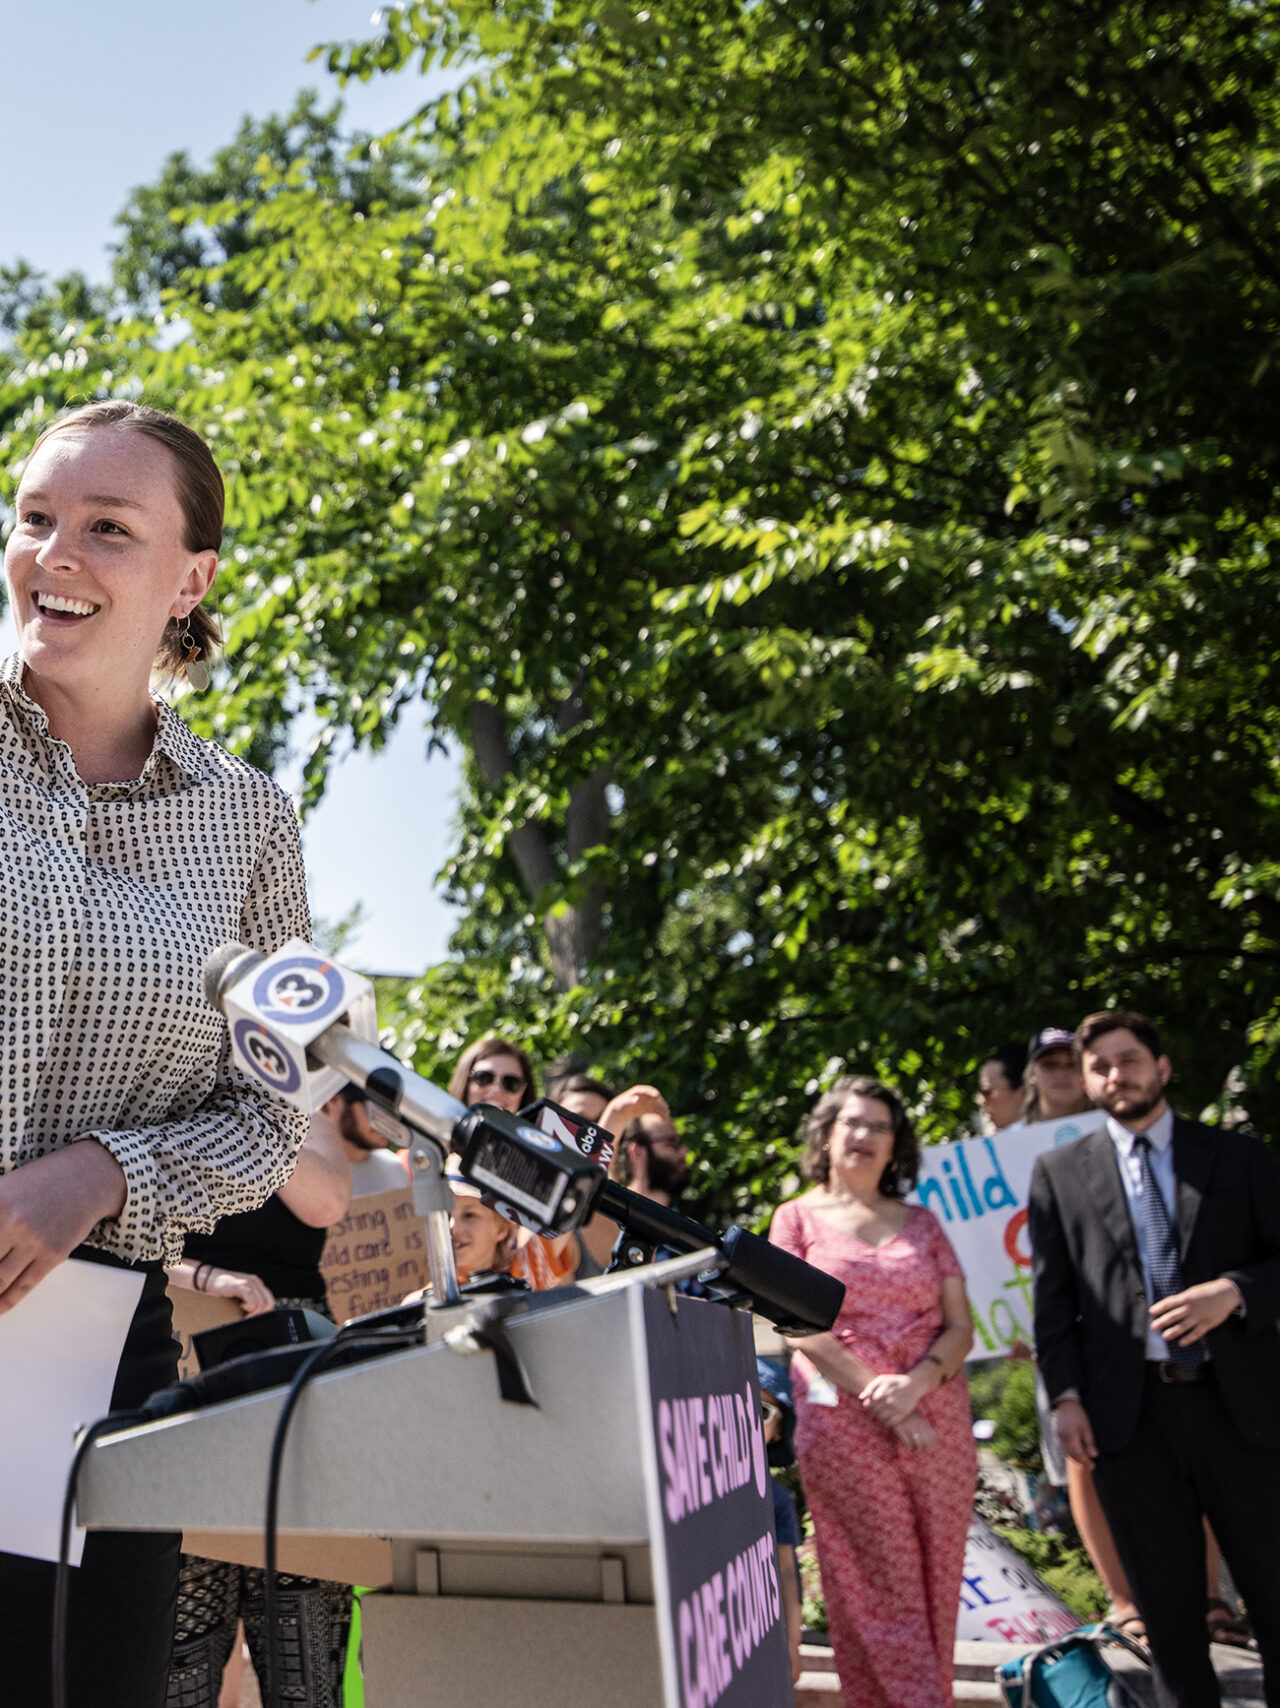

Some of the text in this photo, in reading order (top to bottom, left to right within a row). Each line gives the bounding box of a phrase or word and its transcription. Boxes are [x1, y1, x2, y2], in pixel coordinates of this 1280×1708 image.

[275, 973, 324, 1008] 3
[249, 1037, 287, 1075] 3
[581, 1126, 597, 1154] abc
[658, 1393, 751, 1524] SAVE CHILD
[679, 1531, 781, 1708] CARE COUNTS
